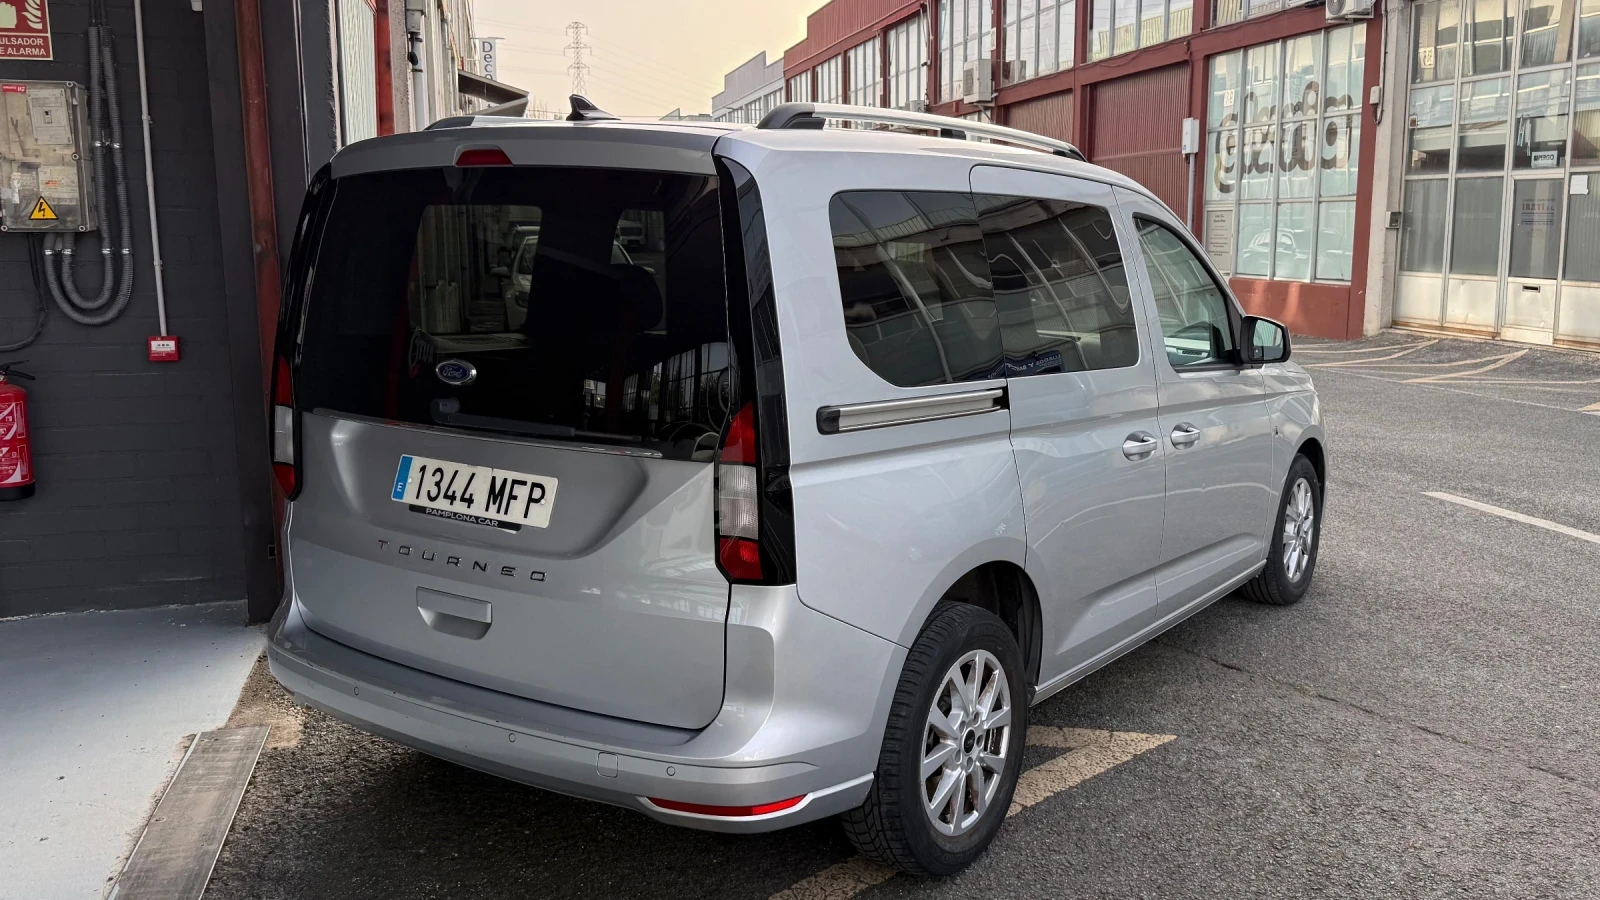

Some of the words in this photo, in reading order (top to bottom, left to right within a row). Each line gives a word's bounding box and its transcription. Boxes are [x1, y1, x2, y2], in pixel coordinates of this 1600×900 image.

[7, 47, 46, 55] ALARMA
[396, 482, 404, 492] E
[415, 464, 476, 509] 1344
[485, 475, 546, 519] MFP
[425, 507, 477, 524] PAMPLONA
[478, 517, 499, 527] CAR
[377, 539, 548, 582] TOURNEO
